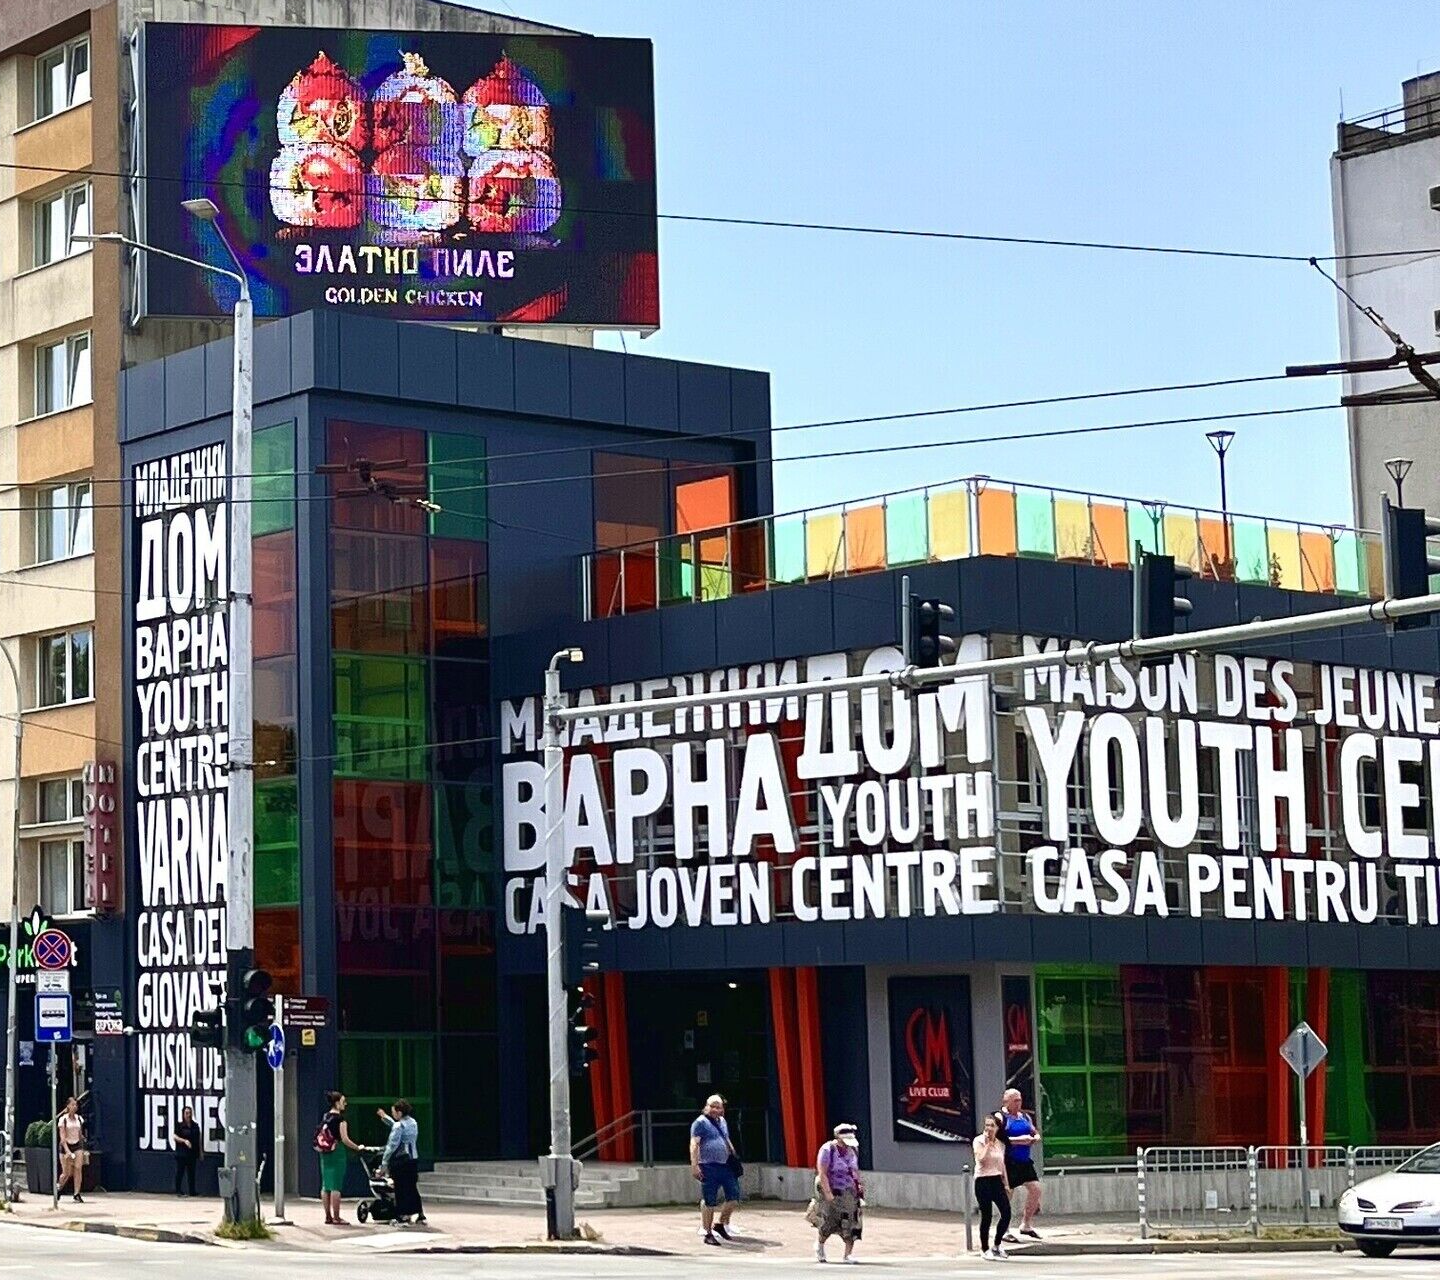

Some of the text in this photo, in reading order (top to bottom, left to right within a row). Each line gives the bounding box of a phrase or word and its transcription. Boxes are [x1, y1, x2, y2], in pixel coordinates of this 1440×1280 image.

[295, 244, 515, 278] ЗЛАТНО ПИЛЕ
[325, 287, 484, 307] GOLDEN CHICKEN
[135, 443, 227, 518] МЛАДЕЖКИ
[136, 503, 228, 621] ДОМ
[136, 612, 228, 680] ВАРНА
[1022, 634, 1440, 734] MAISON DES JEUNE
[136, 670, 229, 738] YOUTH
[797, 633, 993, 780] ДОМ
[137, 732, 229, 797] CENTRE
[502, 732, 797, 872] ВАРНА
[1021, 706, 1308, 854] YOUTH
[820, 771, 996, 848] YOUTH
[137, 793, 228, 907] VARNA
[628, 861, 772, 930] JOVEN
[792, 846, 999, 921] CENTRE
[1030, 846, 1170, 918] CASA
[1188, 854, 1379, 924] PENTRU
[138, 907, 227, 967] CASA DEL
[139, 1032, 225, 1090] MAISON DE
[910, 1087, 950, 1097] LIVE CLUB
